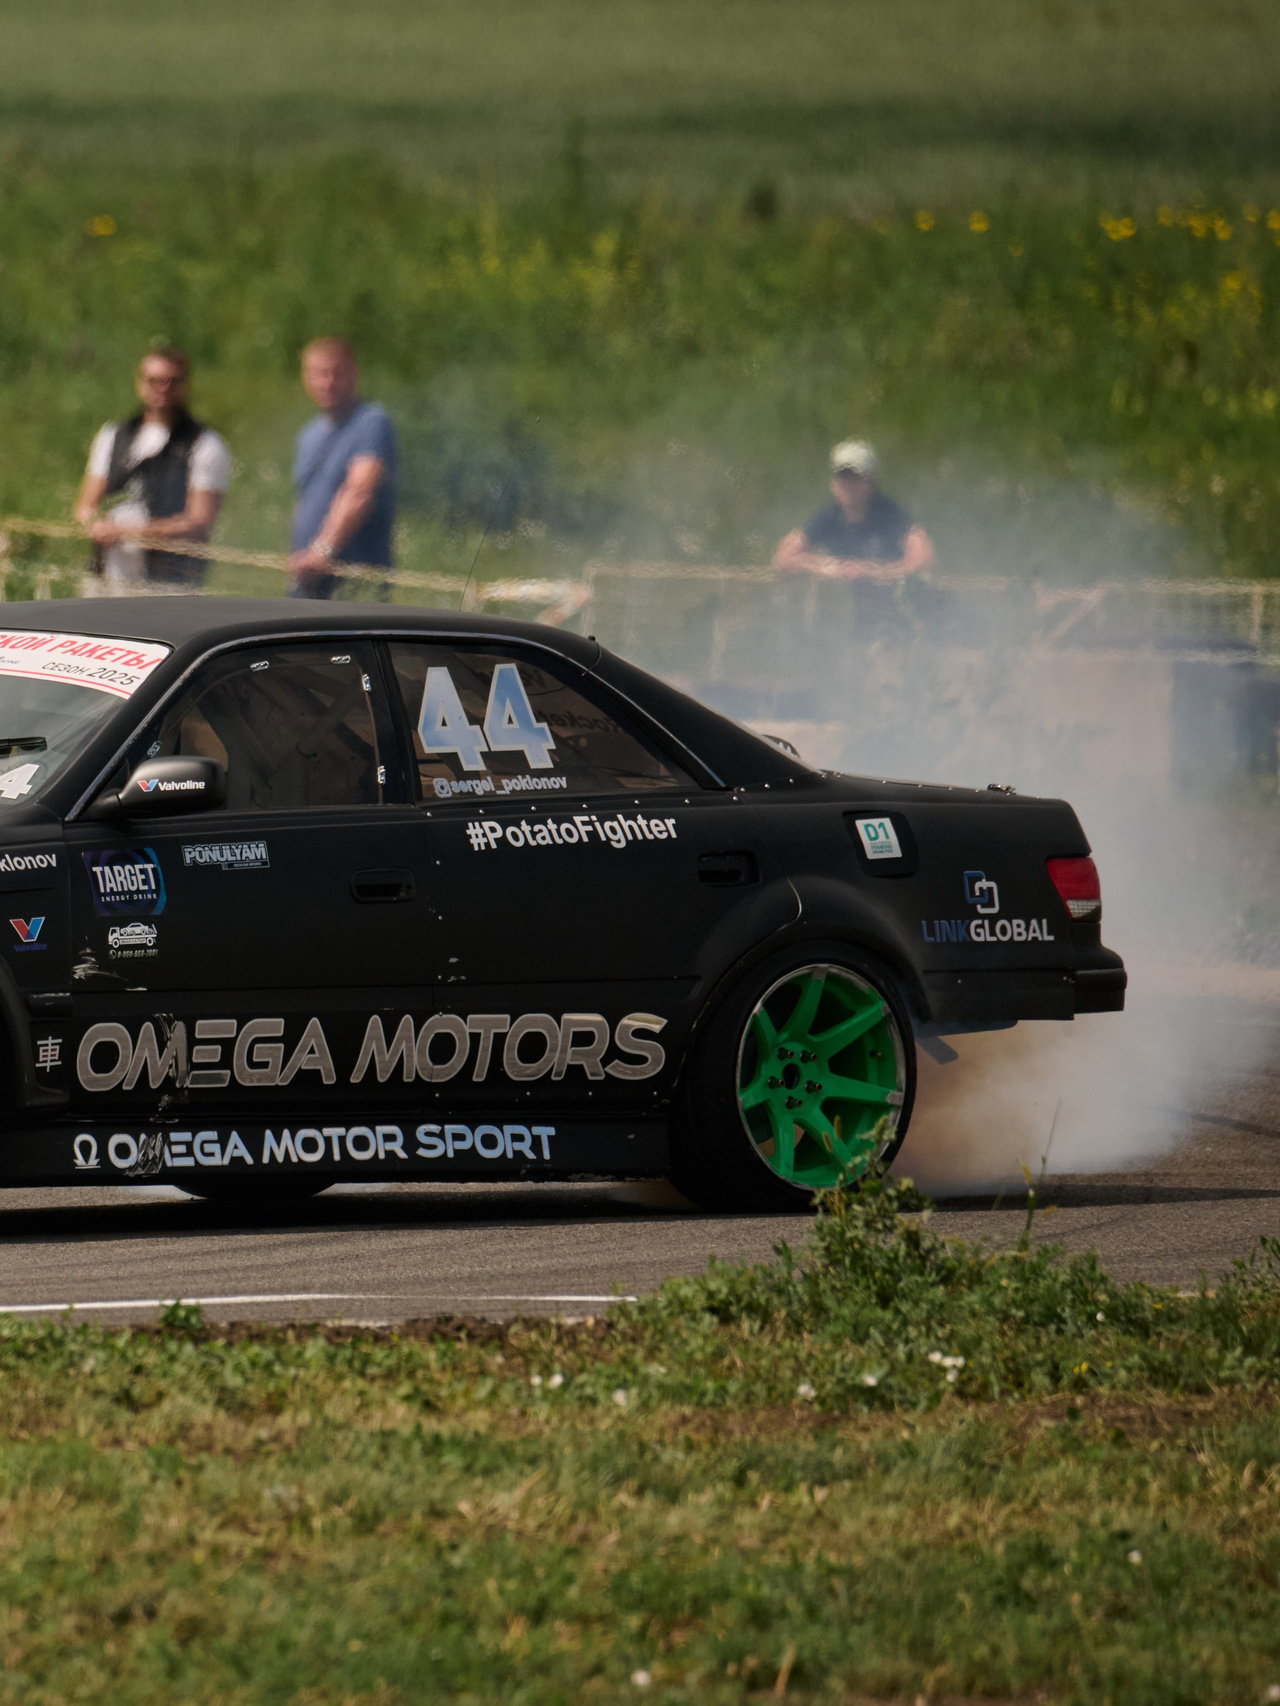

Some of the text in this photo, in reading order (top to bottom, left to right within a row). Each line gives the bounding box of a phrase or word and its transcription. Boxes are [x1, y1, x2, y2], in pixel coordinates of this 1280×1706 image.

[47, 639, 165, 670] РАКЕТЫ
[41, 661, 141, 686] СЕЗОН 2025
[418, 663, 556, 771] 44
[157, 779, 205, 792] Valvoline
[466, 814, 678, 851] #PotatoFighter
[863, 822, 890, 842] D1
[184, 842, 267, 865] PONULYAM
[92, 864, 157, 893] TARGET
[13, 942, 48, 952] Valvoline
[35, 1036, 63, 1072] 車
[77, 1013, 668, 1091] OMEGA MOTORS
[262, 1125, 408, 1165] MOTOR
[415, 1124, 556, 1161] SPORT
